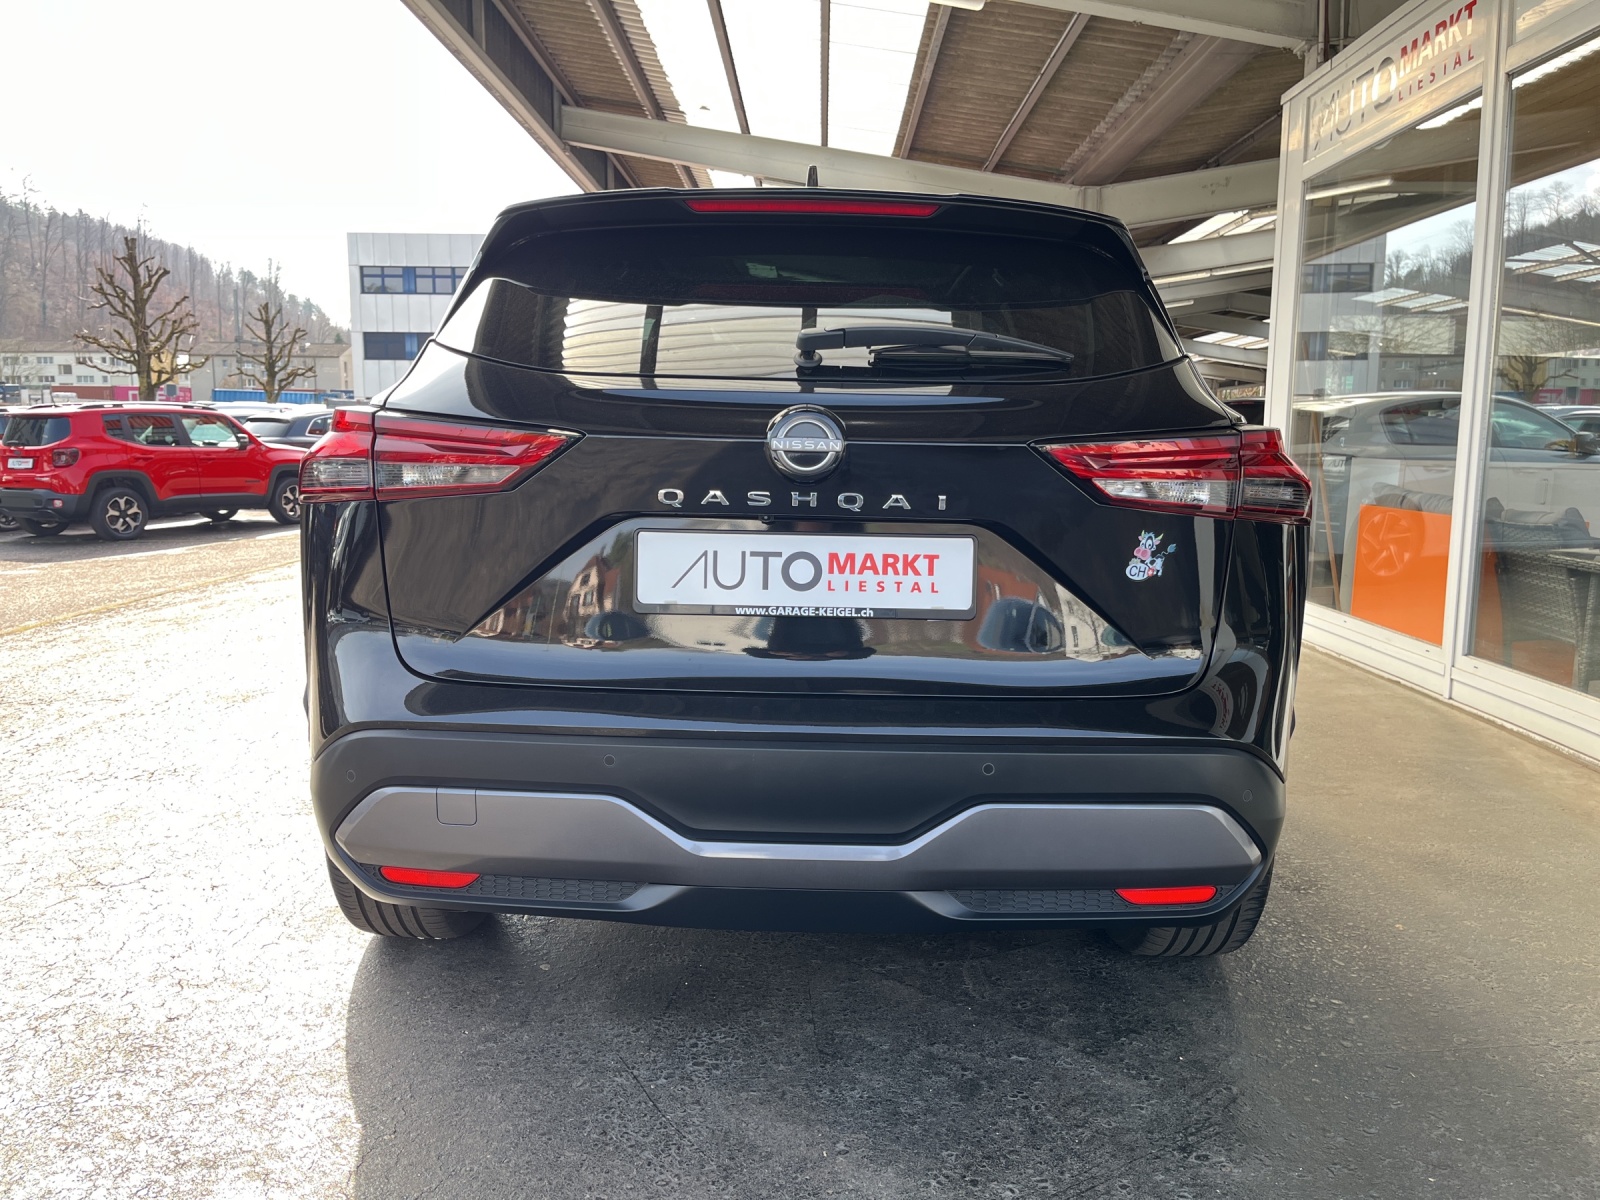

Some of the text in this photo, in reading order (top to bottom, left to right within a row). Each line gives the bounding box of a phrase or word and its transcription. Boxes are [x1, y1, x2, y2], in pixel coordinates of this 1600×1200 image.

[1400, 0, 1477, 79] MARKT
[1398, 44, 1475, 102] LIESTAL
[772, 438, 841, 451] NISSAN
[657, 488, 946, 512] QASHQAI
[671, 549, 940, 592] AUTO MARKT
[1129, 565, 1147, 578] CH
[827, 579, 939, 594] LIESTAL
[735, 605, 874, 618] www.GARAGE-KEIGEL.ch
